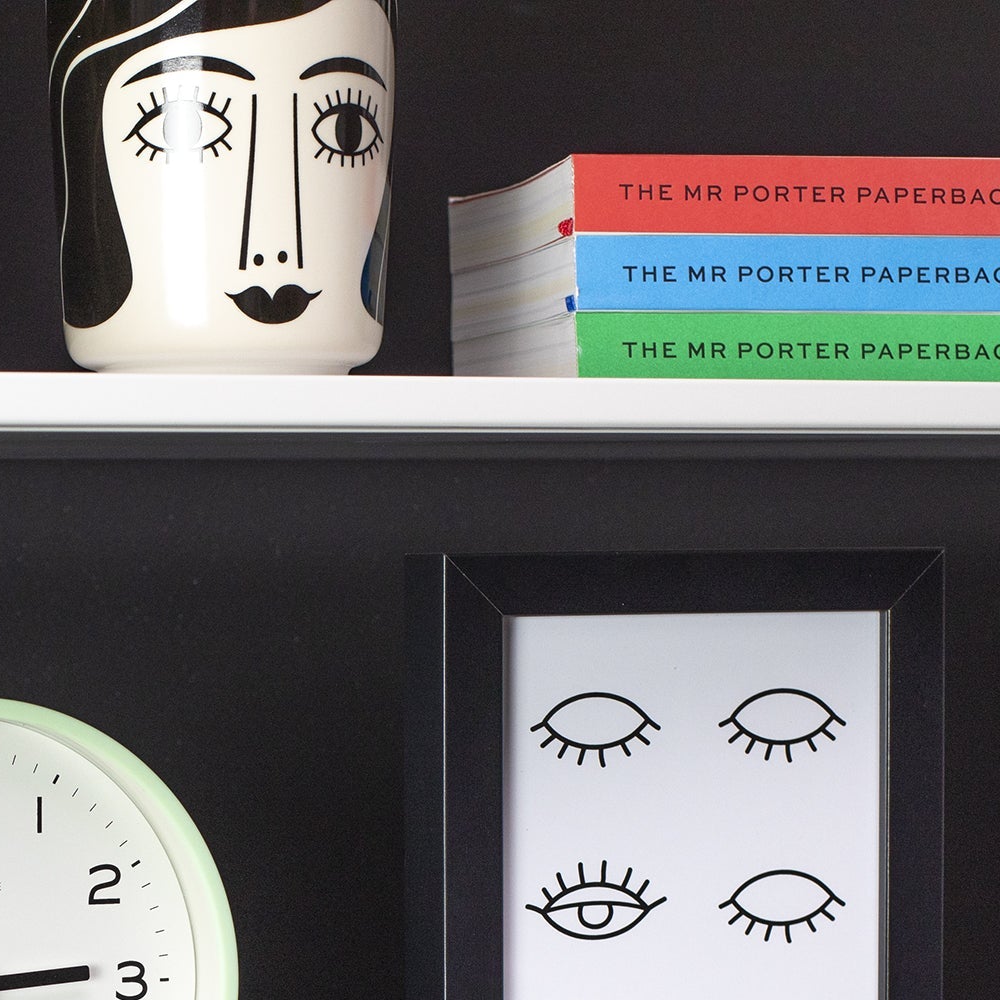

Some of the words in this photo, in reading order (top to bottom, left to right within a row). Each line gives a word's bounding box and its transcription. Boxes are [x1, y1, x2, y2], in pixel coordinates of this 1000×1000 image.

[618, 183, 673, 201] THE
[684, 184, 722, 202] MR
[734, 185, 845, 204] PORTER
[622, 265, 677, 282] THE
[688, 265, 726, 283] MR
[738, 265, 850, 283] PORTER
[622, 342, 677, 359] THE
[688, 342, 726, 359] MR
[738, 342, 849, 359] PORTER
[36, 796, 43, 834] 1
[87, 863, 122, 905] 2
[115, 960, 148, 1000] 3
